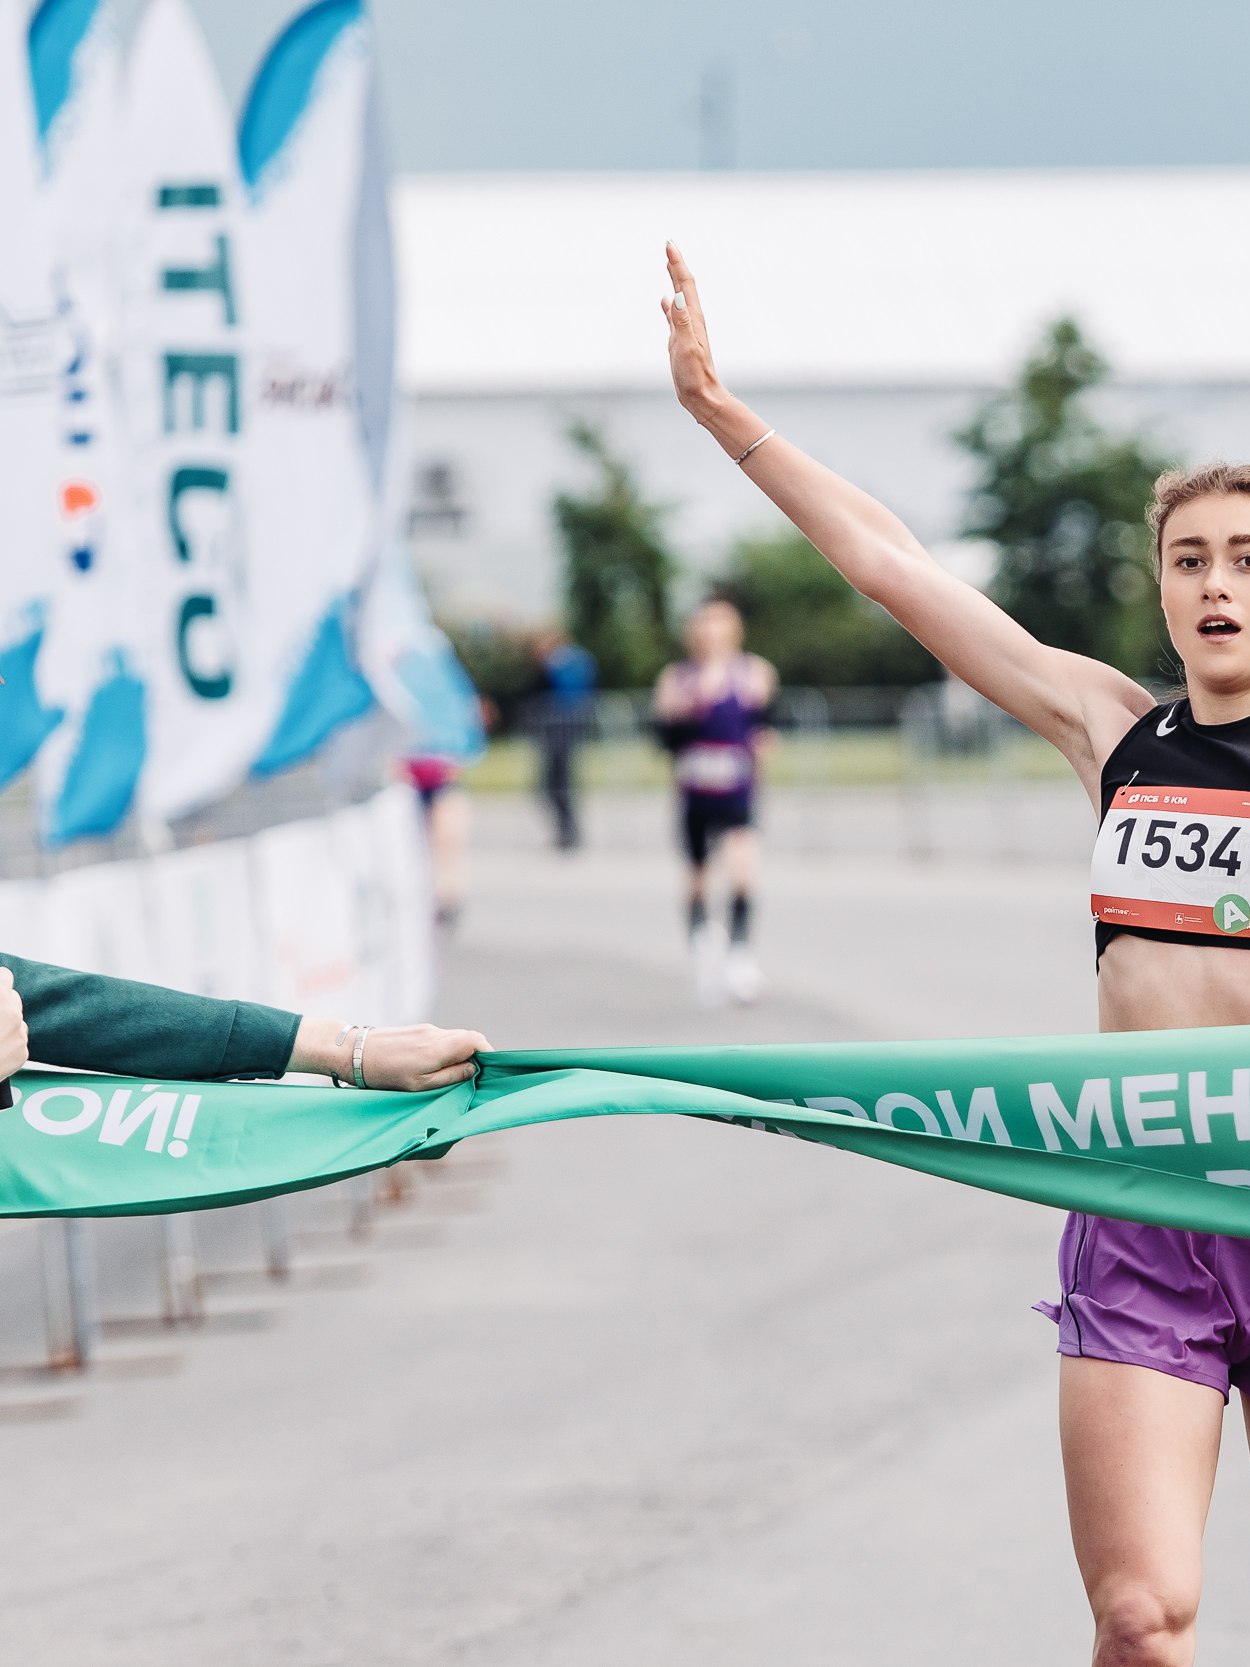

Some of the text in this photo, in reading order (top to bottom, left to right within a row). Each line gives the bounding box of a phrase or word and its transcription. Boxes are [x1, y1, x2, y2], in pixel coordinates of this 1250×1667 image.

[155, 183, 241, 701] ITECO
[1140, 794, 1159, 803] ПСБ
[1163, 795, 1170, 804] 5
